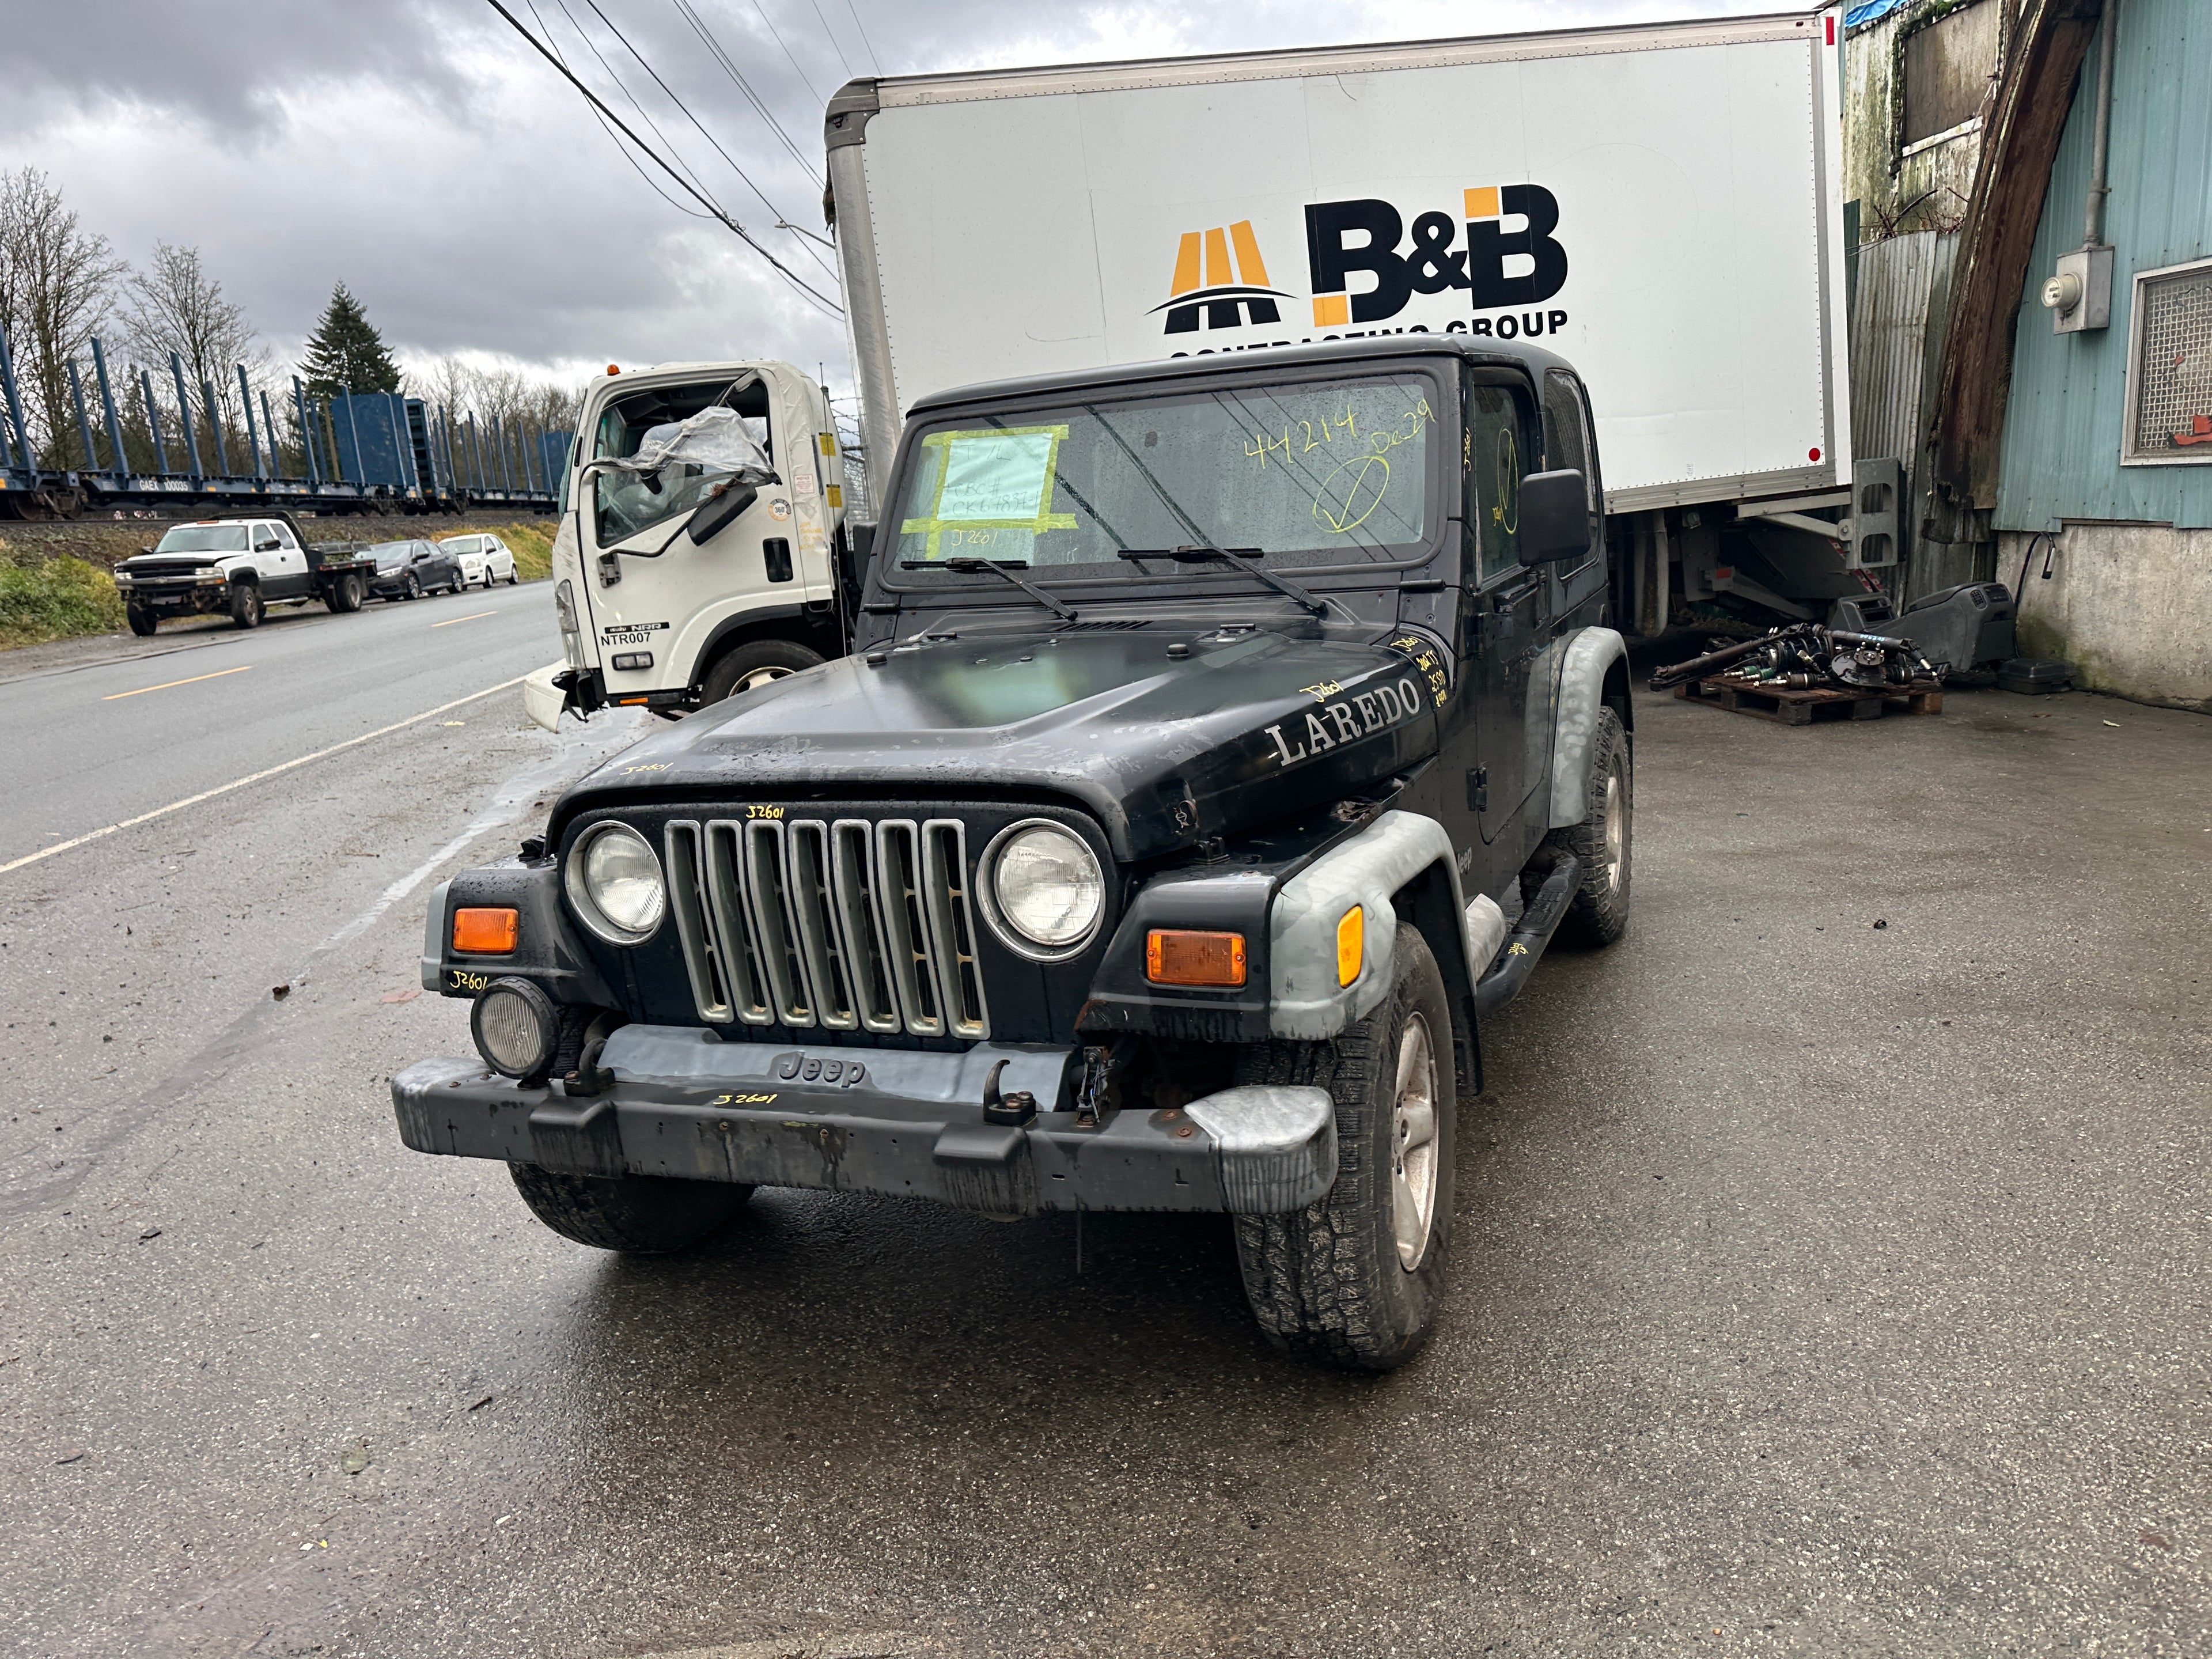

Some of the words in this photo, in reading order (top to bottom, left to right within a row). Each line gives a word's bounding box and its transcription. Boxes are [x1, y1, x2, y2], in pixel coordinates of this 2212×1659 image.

[1304, 183, 1568, 327] B&B
[1446, 309, 1567, 340] GROUP
[1243, 404, 1358, 469] 44214
[139, 479, 159, 491] GAEX
[164, 480, 188, 491] 100035
[600, 632, 651, 646] NTR007
[631, 623, 662, 631] NRR
[1264, 678, 1420, 767] LAREDO
[745, 804, 784, 819] J2601
[450, 970, 487, 990] J2601
[779, 1050, 866, 1088] Jeep
